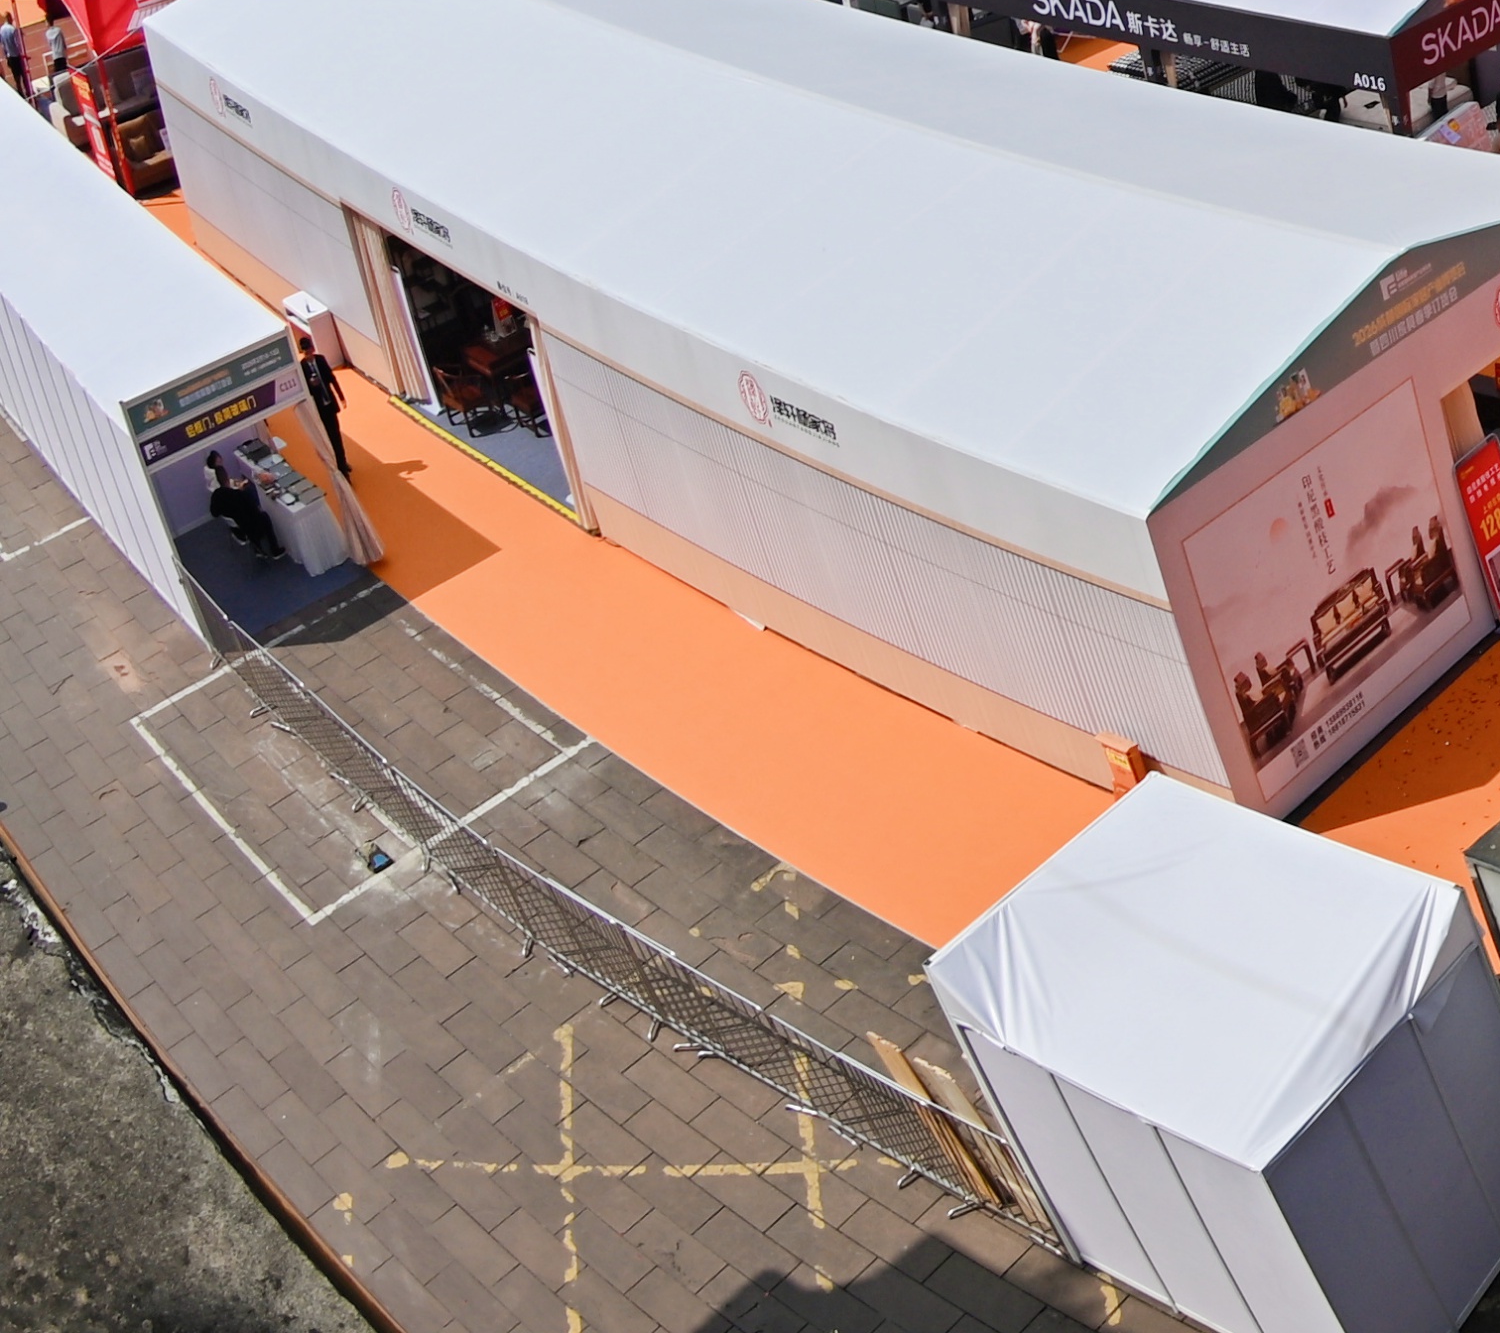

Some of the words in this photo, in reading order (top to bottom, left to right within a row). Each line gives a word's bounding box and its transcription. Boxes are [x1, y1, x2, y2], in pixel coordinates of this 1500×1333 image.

[1127, 9, 1179, 44] 斯卡达
[1352, 72, 1388, 92] A016
